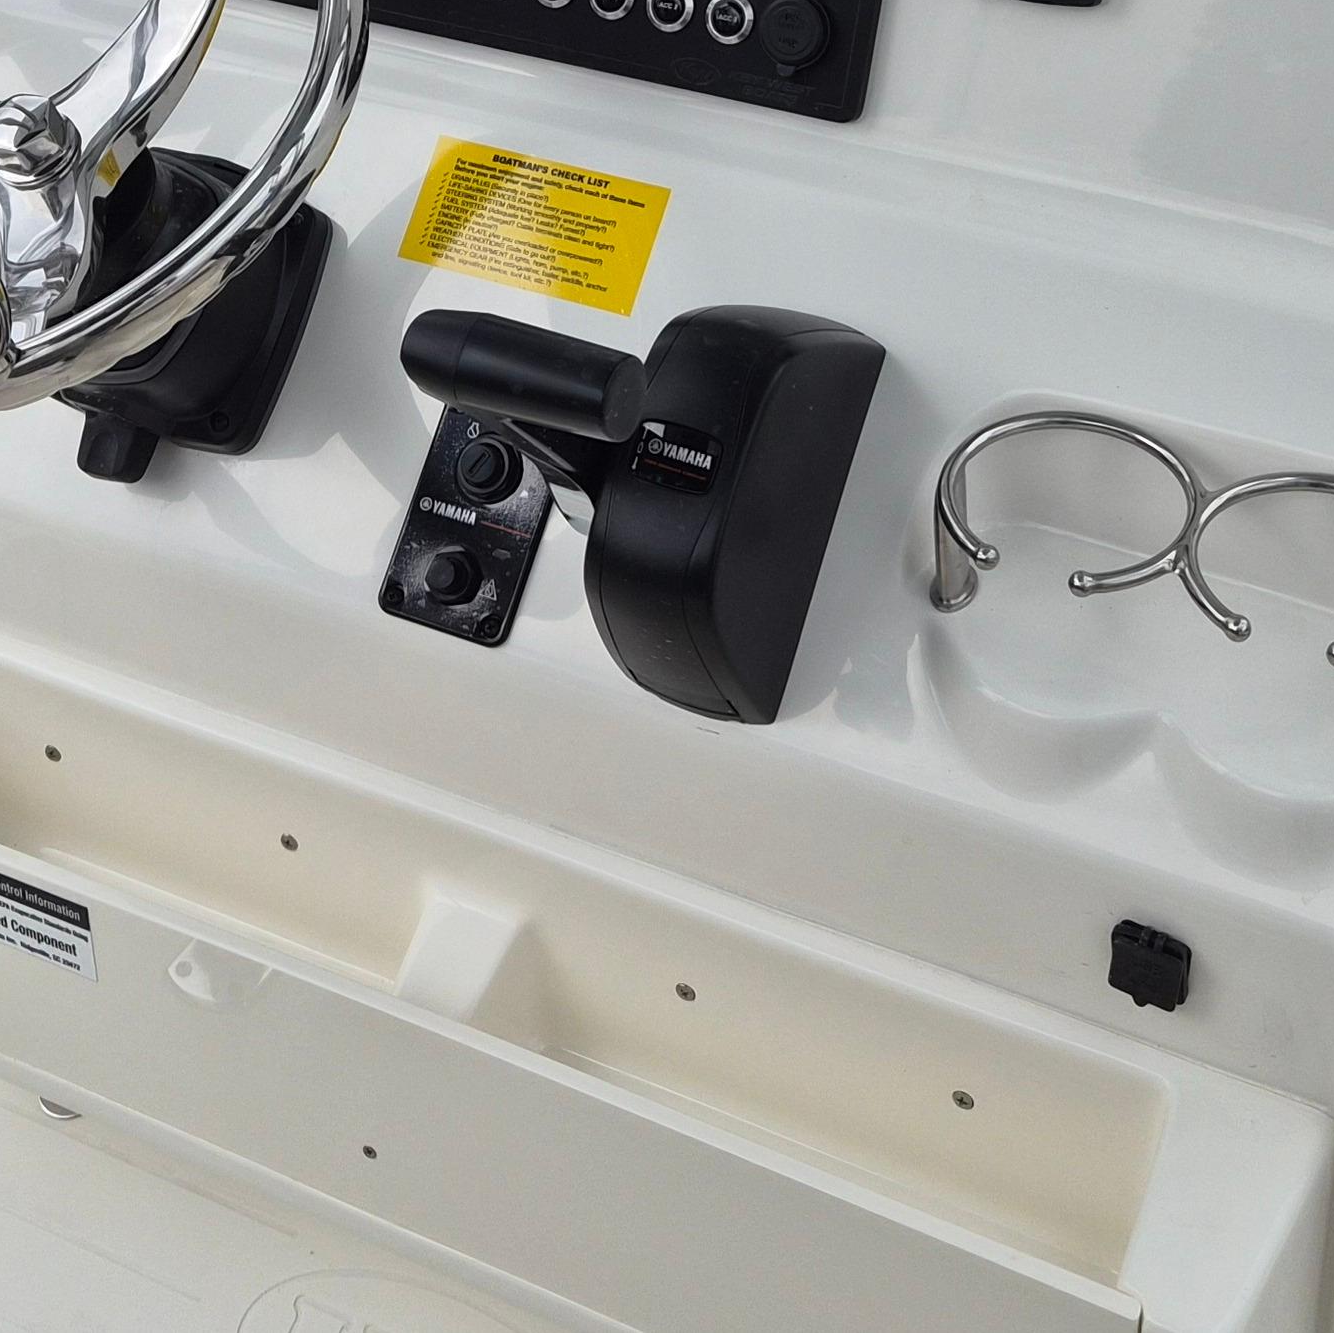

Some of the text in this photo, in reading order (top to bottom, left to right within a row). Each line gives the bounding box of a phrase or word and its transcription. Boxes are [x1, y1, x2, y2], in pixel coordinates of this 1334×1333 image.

[450, 173, 472, 183] DRAIN
[491, 153, 610, 188] BOATMAN'S CHECK LIST
[442, 195, 460, 204] FUEL
[478, 195, 505, 207] SYSTEM
[663, 442, 712, 470] YAMAHA
[433, 500, 477, 526] YAMAHA
[25, 890, 79, 921] Information
[11, 918, 76, 958] Component
